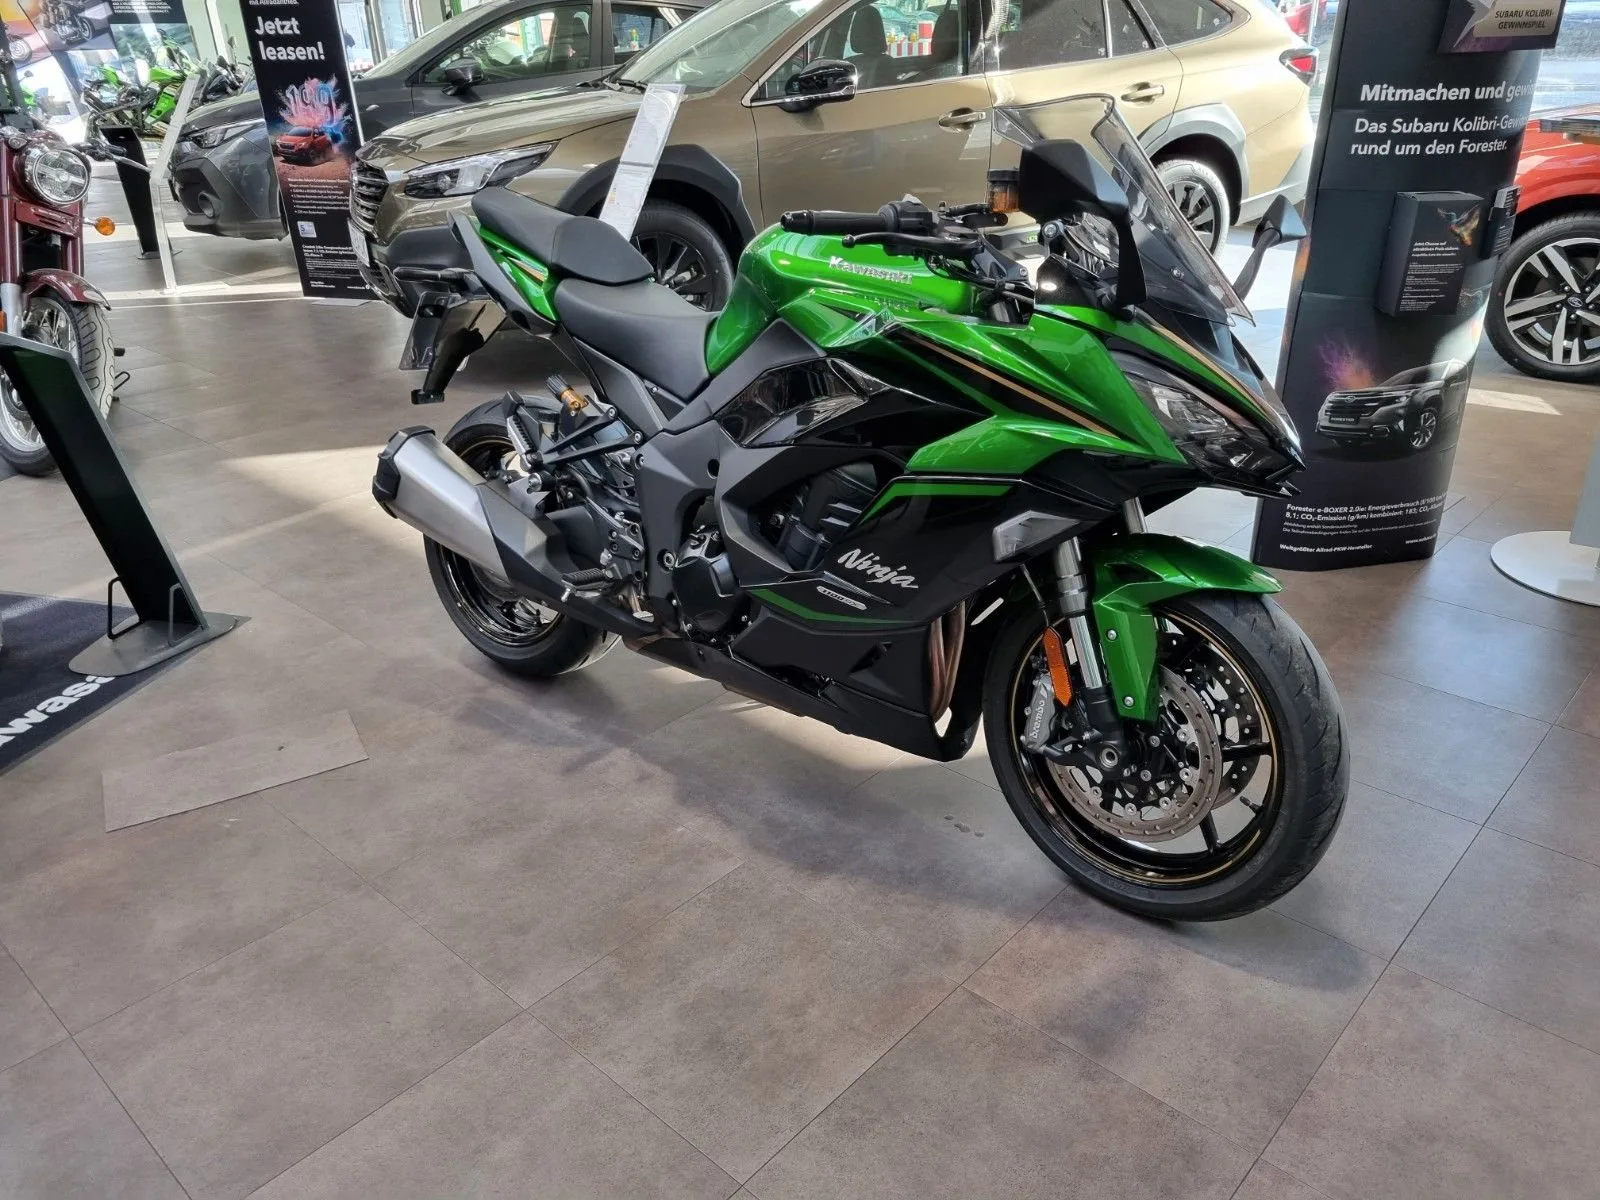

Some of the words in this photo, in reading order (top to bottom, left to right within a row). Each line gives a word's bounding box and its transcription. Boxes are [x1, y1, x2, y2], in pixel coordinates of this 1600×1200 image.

[1495, 10, 1524, 19] SUBARU
[1525, 9, 1554, 18] KOLIBRI-
[254, 16, 301, 35] Jetzt
[1498, 21, 1545, 30] GEWINNSPIEL
[258, 40, 325, 60] leasen!
[1360, 83, 1470, 102] Mitmachen
[1475, 81, 1506, 100] und
[1354, 118, 1387, 133] Das
[1391, 117, 1449, 134] Subaru
[1350, 140, 1391, 155] rund
[1394, 142, 1421, 155] um
[1425, 139, 1455, 155] den
[1458, 138, 1508, 154] Forester.
[829, 255, 913, 284] Kawasaki
[1286, 503, 1316, 513] Forester
[1317, 506, 1348, 514] e-BOXER
[1368, 500, 1419, 511] Energieverbrauch
[1348, 513, 1369, 522] (g/km)
[837, 548, 919, 589] Ninja
[1029, 700, 1046, 739] brembo
